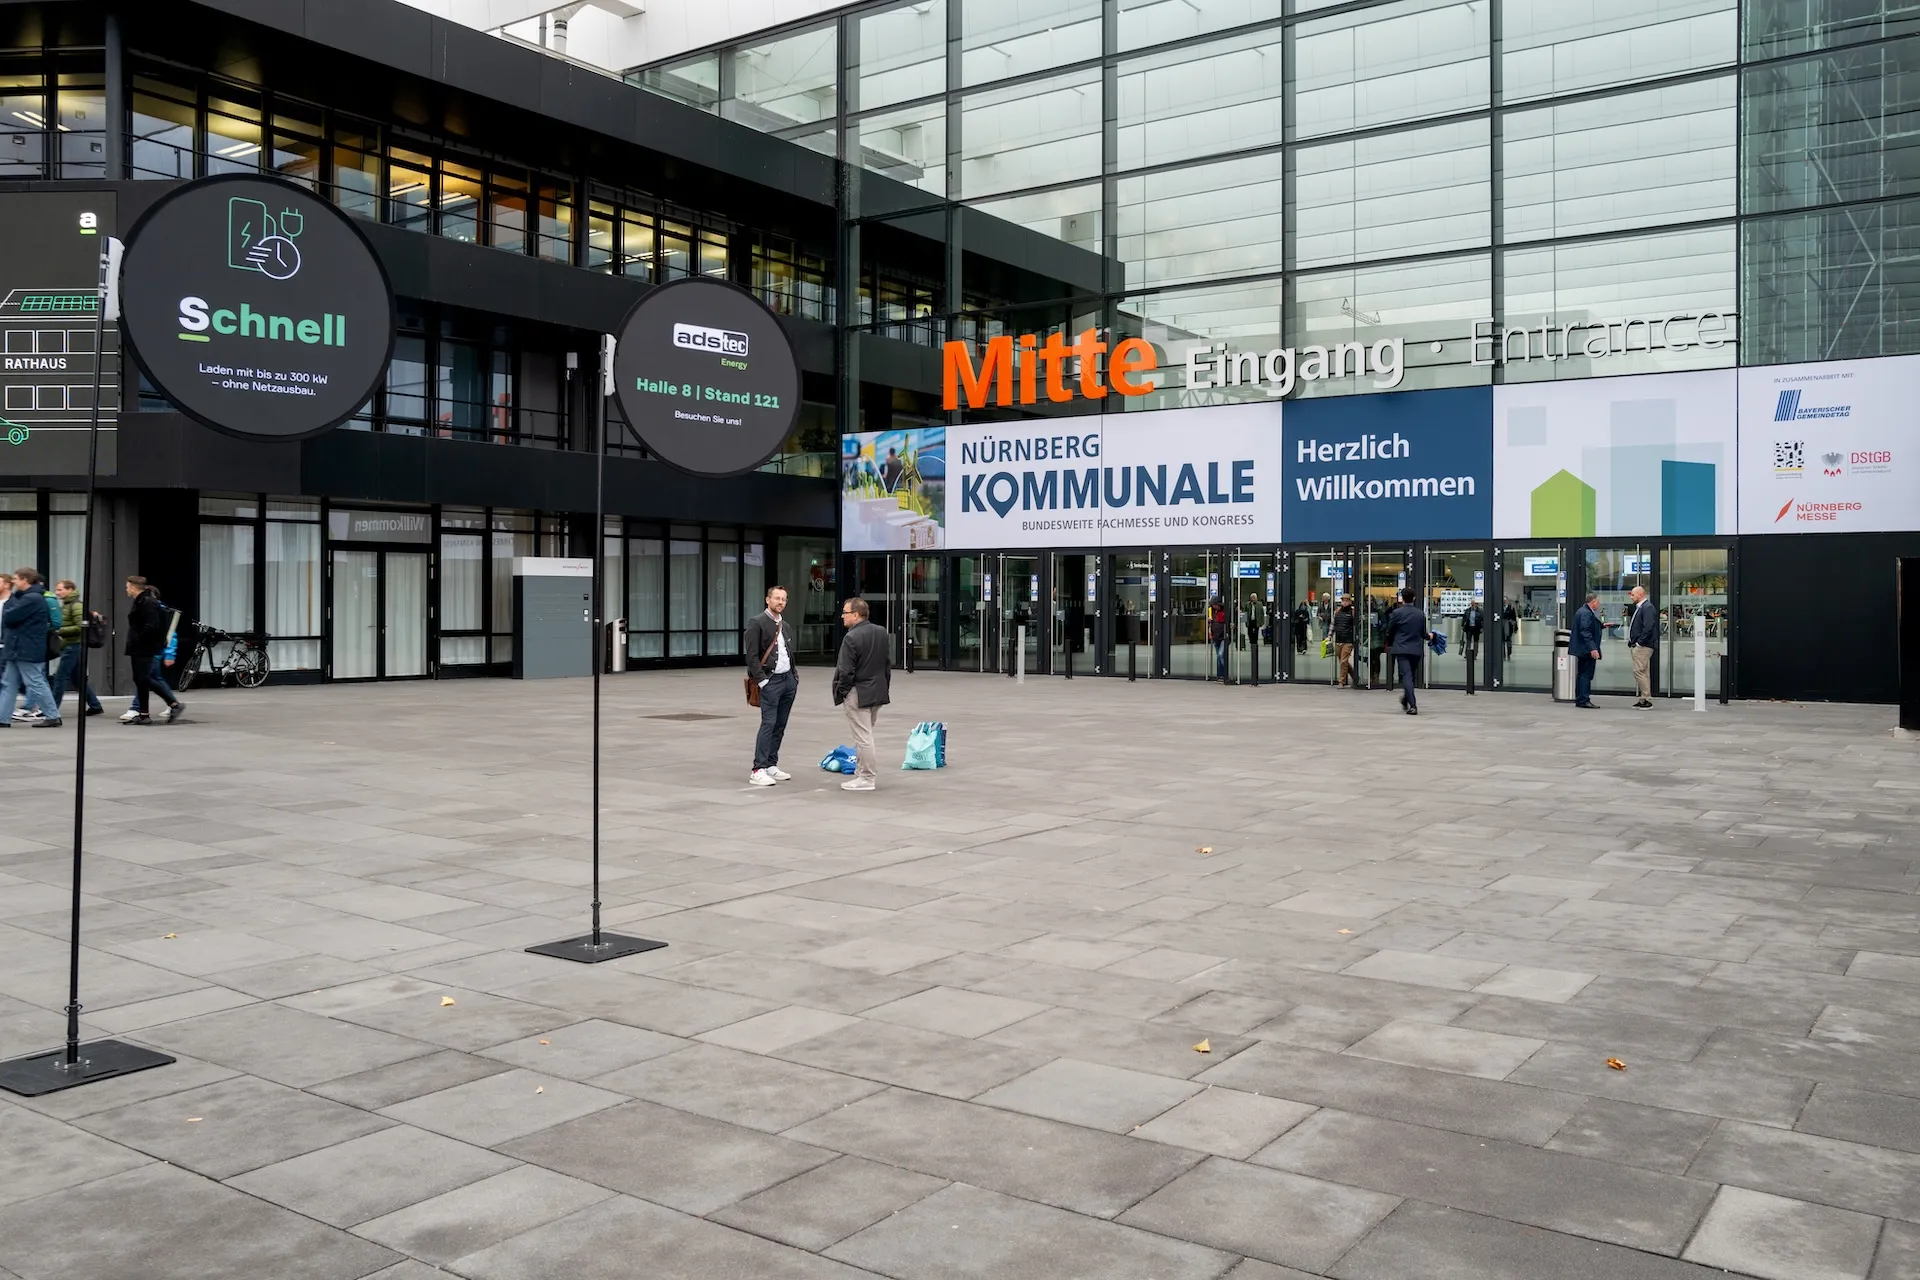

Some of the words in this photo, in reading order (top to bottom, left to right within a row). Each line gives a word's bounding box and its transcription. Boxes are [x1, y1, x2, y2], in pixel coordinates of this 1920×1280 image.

[179, 296, 345, 347] Schnell
[5, 357, 67, 370] RATHAUS
[721, 358, 748, 371] Energy
[942, 327, 1158, 411] Mitte
[1185, 336, 1405, 397] Eingang
[1470, 310, 1727, 367] Entrance
[199, 363, 234, 376] Laden
[237, 367, 253, 378] mit
[256, 369, 272, 380] bis
[275, 372, 287, 381] zu
[289, 371, 310, 383] 300
[312, 374, 328, 385] kW
[1782, 373, 1840, 383] ZUSAMMENARBEIT
[222, 378, 249, 391] ohne
[252, 382, 316, 396] Netzausbau.
[636, 377, 678, 396] Halle
[681, 384, 692, 397] 8
[704, 387, 750, 405] Stand
[754, 394, 780, 409] 121
[674, 410, 711, 423] Besuchen
[712, 414, 724, 425] Sie
[726, 417, 742, 426] uns!
[1797, 411, 1850, 420] GEMEINDETAG
[1798, 405, 1852, 414] BAYERISCHER
[961, 434, 1100, 465] NÜRNBERG
[1296, 432, 1409, 464] Herzlich
[1851, 451, 1891, 464] DStGB
[961, 459, 1255, 519] KOMMUNALE
[1296, 474, 1475, 502] Willkommen
[1796, 502, 1862, 512] NÜRNBERG
[1022, 519, 1093, 531] BUNDESWEITE
[1097, 517, 1160, 529] FACHMESSE
[1164, 516, 1189, 527] UND
[1192, 514, 1254, 526] KONGRESS
[1796, 512, 1837, 521] MESSE
